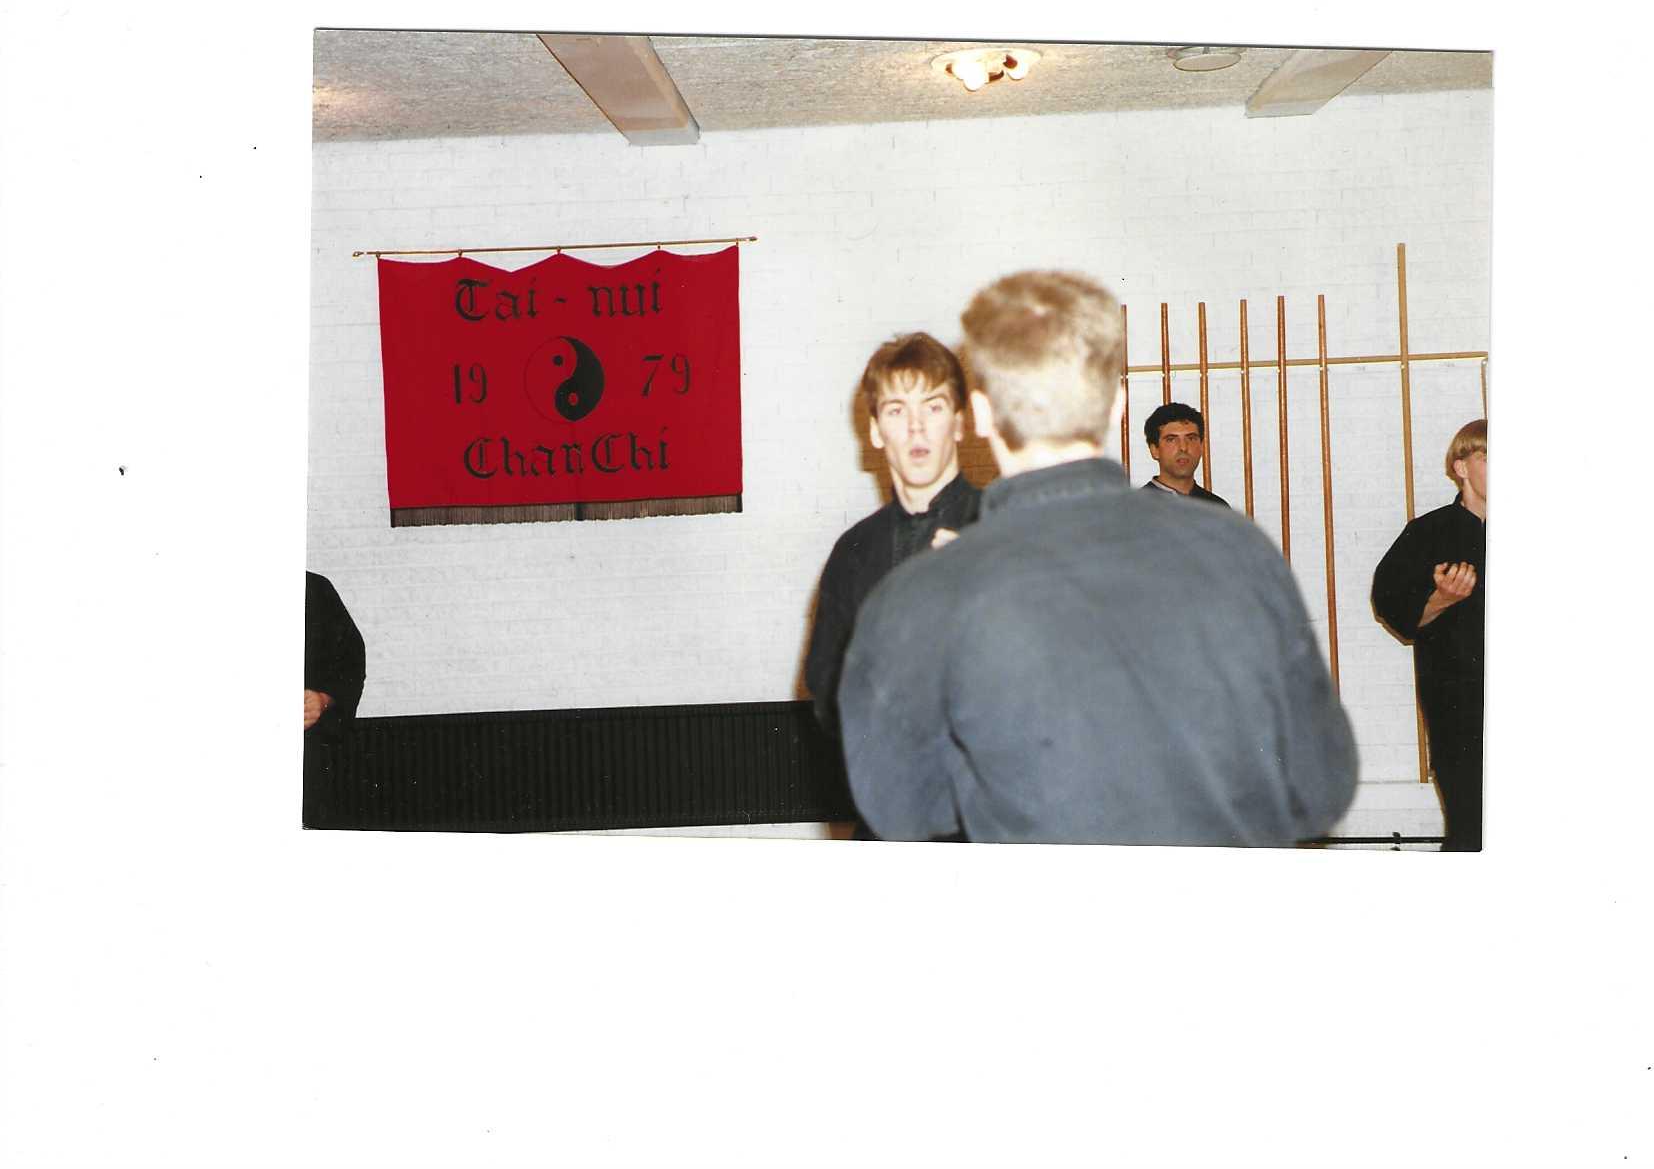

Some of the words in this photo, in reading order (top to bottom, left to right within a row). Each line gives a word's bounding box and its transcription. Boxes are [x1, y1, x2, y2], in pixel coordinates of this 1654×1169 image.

[455, 277, 541, 321] Tai
[588, 268, 664, 318] nui
[453, 362, 488, 405] 19
[641, 354, 691, 397] 79
